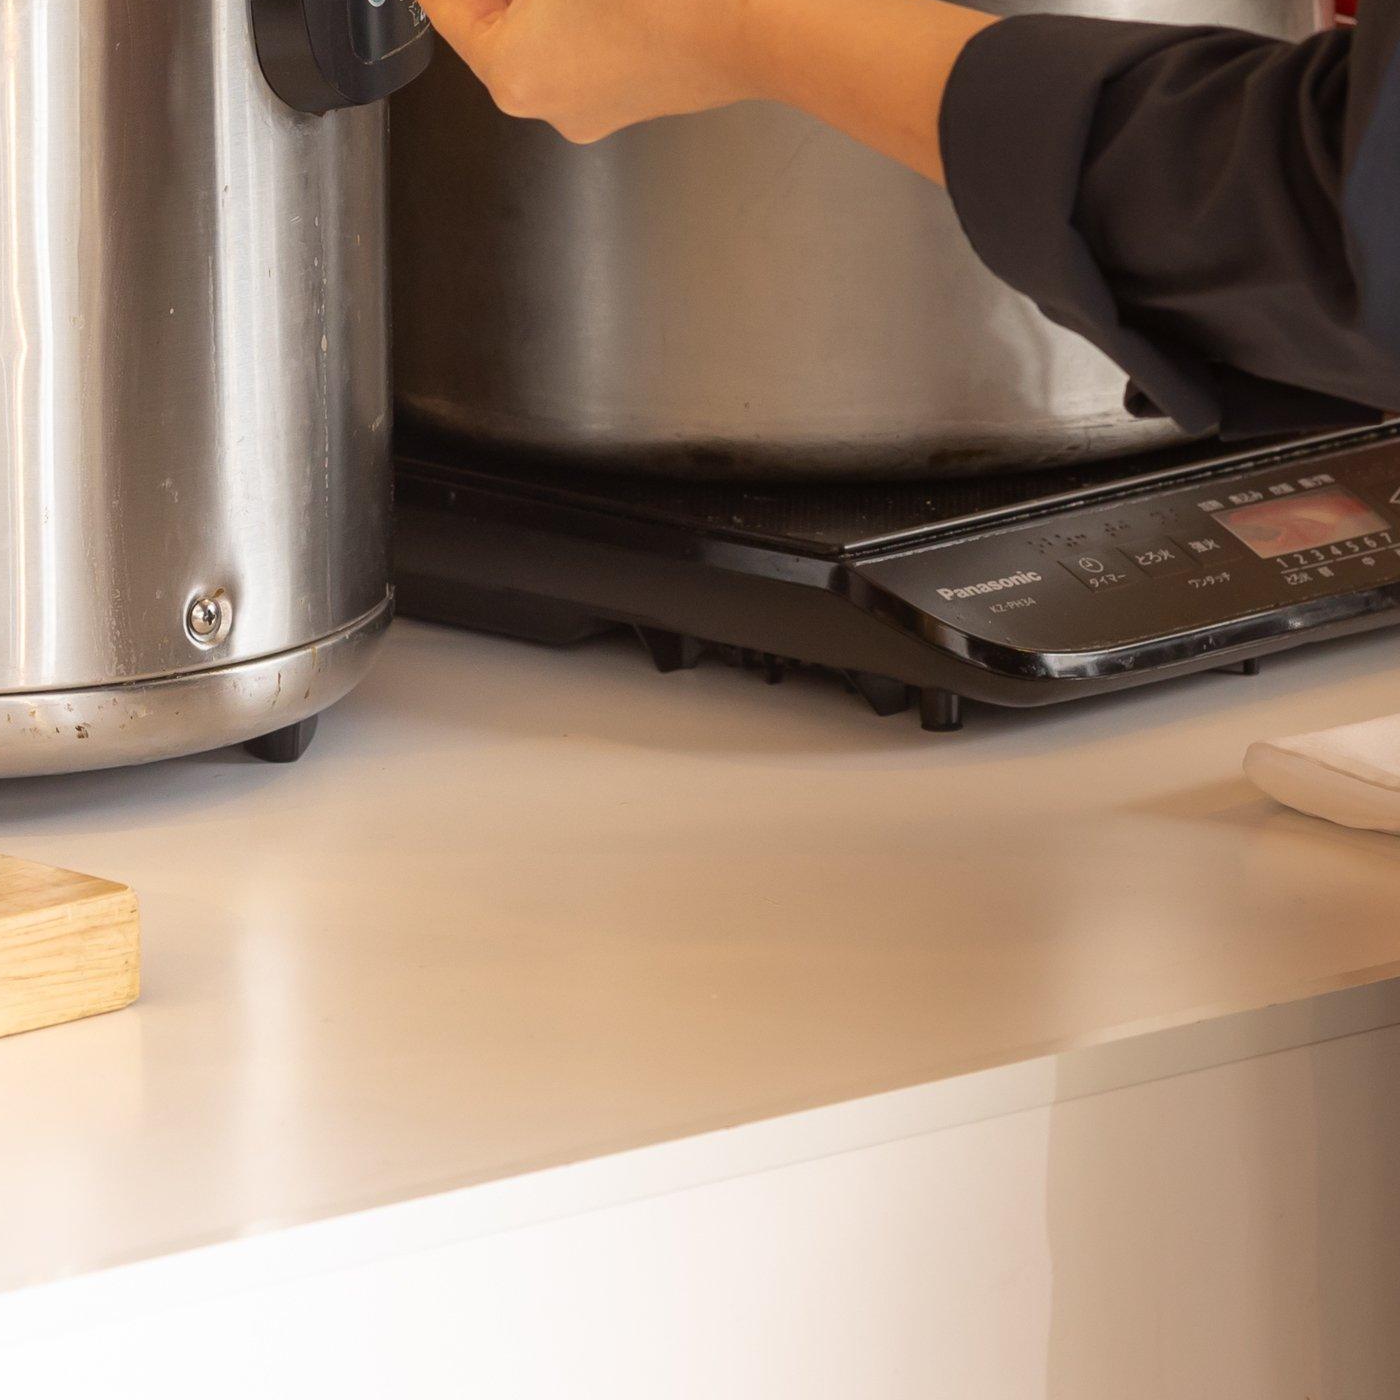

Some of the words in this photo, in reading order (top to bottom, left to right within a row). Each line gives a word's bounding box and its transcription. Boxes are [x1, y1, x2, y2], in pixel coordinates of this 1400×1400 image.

[1135, 549, 1175, 566] とろ火
[1276, 557, 1288, 568] 1
[1293, 553, 1308, 565] 2
[1310, 549, 1325, 560] 3
[1330, 545, 1342, 556] 4
[1345, 541, 1360, 552] 5
[1364, 536, 1377, 548] 6
[1380, 532, 1392, 543] 7
[936, 571, 1042, 601] Panasonic
[1089, 573, 1126, 588] タイマー
[1187, 572, 1231, 589] ワンタッチ
[989, 597, 1038, 614] KZ-PH34
